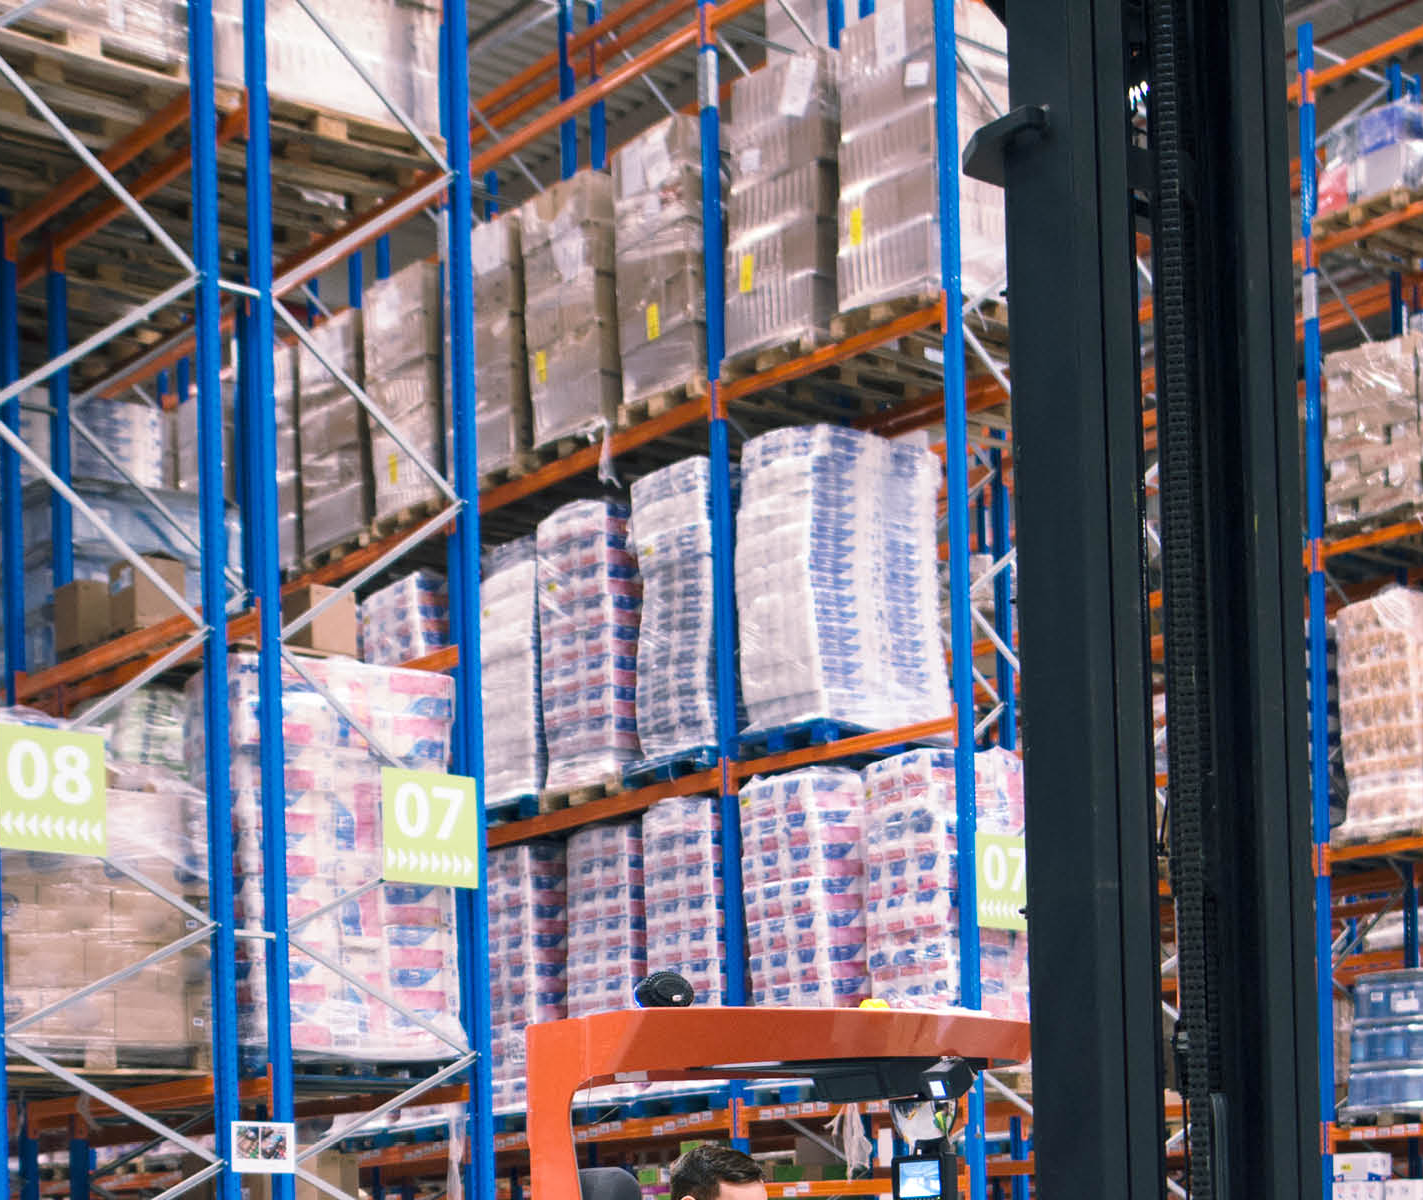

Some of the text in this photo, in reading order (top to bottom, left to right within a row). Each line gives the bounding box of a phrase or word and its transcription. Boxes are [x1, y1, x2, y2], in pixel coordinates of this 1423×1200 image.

[7, 739, 93, 805] 08
[394, 782, 465, 840] 07
[983, 844, 1025, 893] 07
